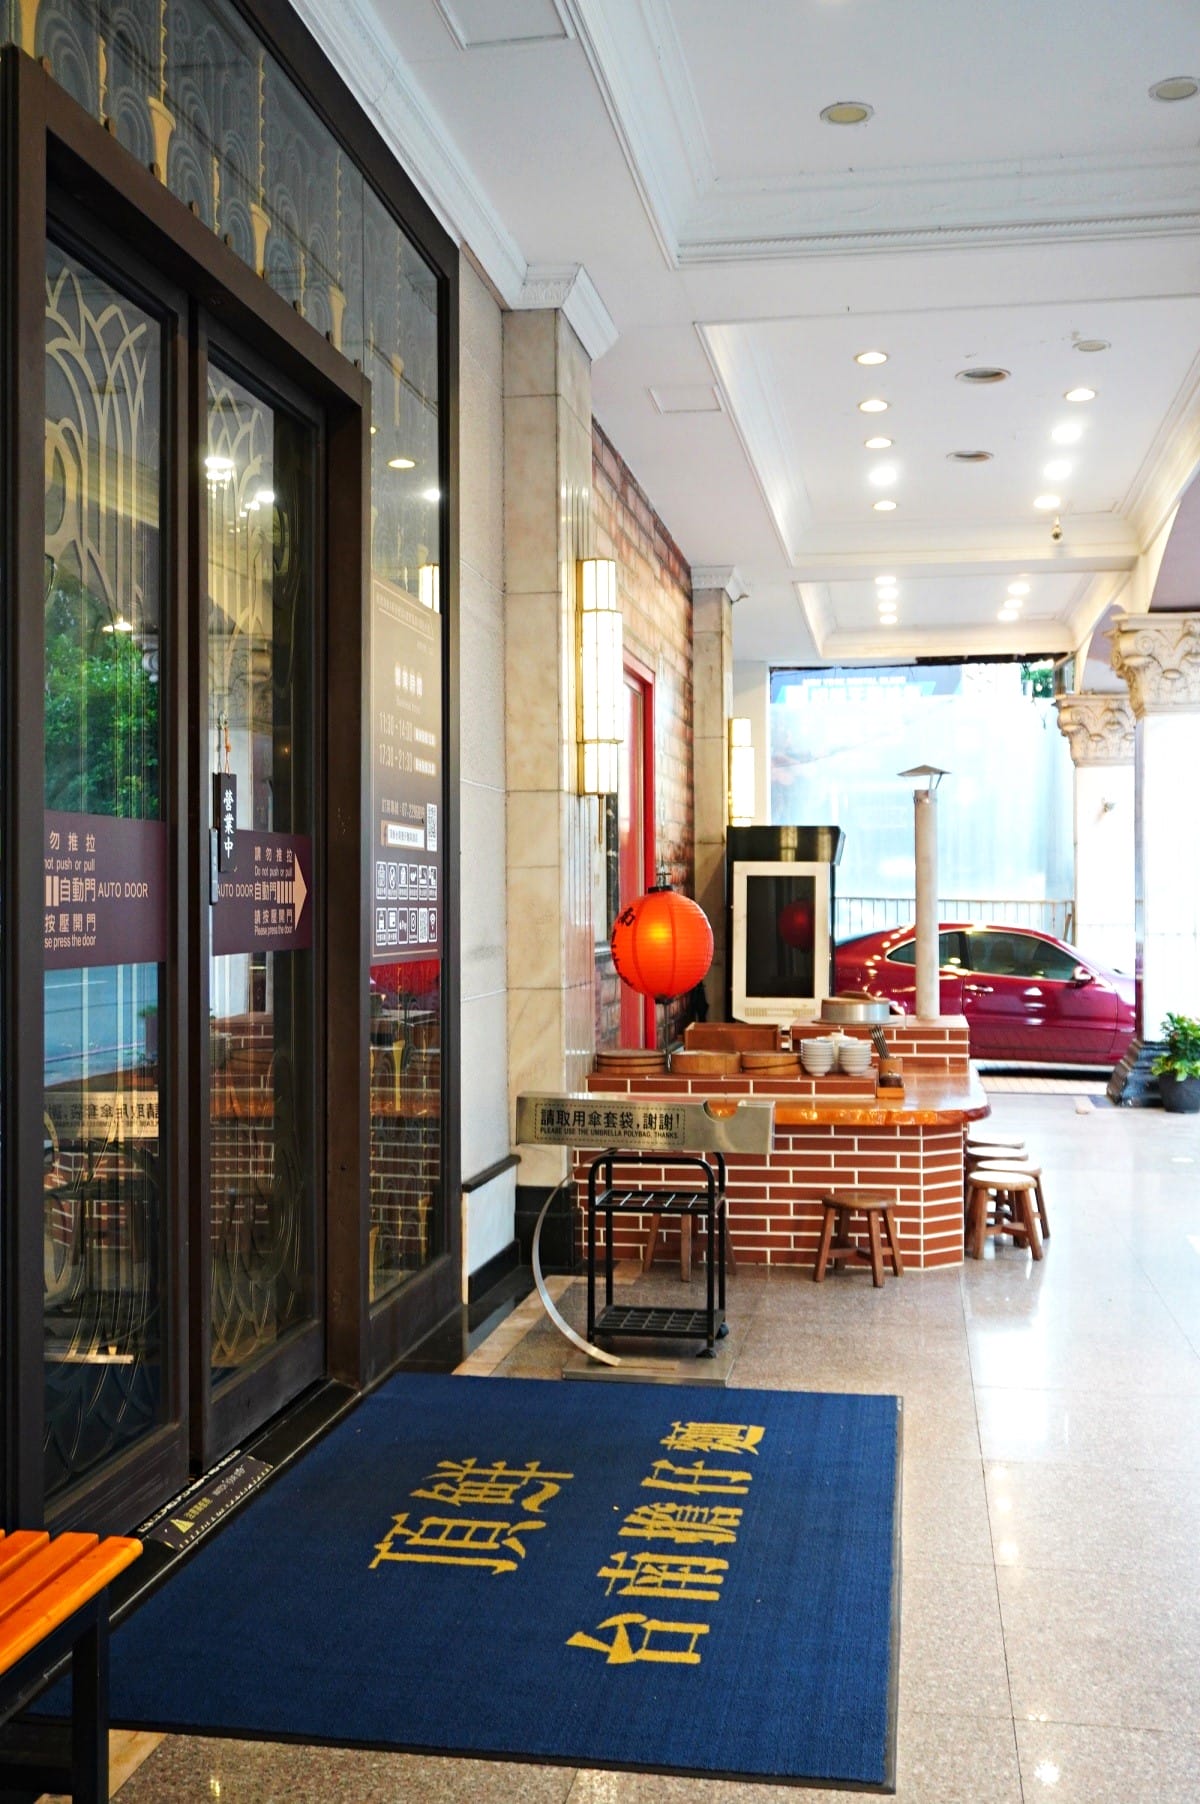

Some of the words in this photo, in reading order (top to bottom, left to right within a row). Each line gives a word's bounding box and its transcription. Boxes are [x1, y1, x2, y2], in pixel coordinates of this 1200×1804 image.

[223, 789, 234, 859] 營業中
[49, 830, 96, 852] 勿推拉
[56, 858, 72, 872] push
[75, 861, 81, 870] or
[84, 858, 95, 873] pull
[254, 865, 260, 876] Do
[270, 867, 279, 877] push
[60, 877, 96, 902] 自動門
[98, 882, 121, 897] AUTO
[125, 883, 148, 898] DOOR
[236, 884, 253, 897] DOOR
[254, 881, 277, 901] 自動門
[45, 913, 96, 933] 按壓開門
[54, 936, 71, 951] press
[71, 934, 81, 947] the
[82, 934, 96, 946] door
[540, 1127, 562, 1135] PLEASE
[578, 1128, 589, 1136] THE
[590, 1129, 622, 1137] UMBRELLA
[368, 1456, 574, 1575] 頂鮮
[565, 1421, 766, 1664] 台南擔仔麵
